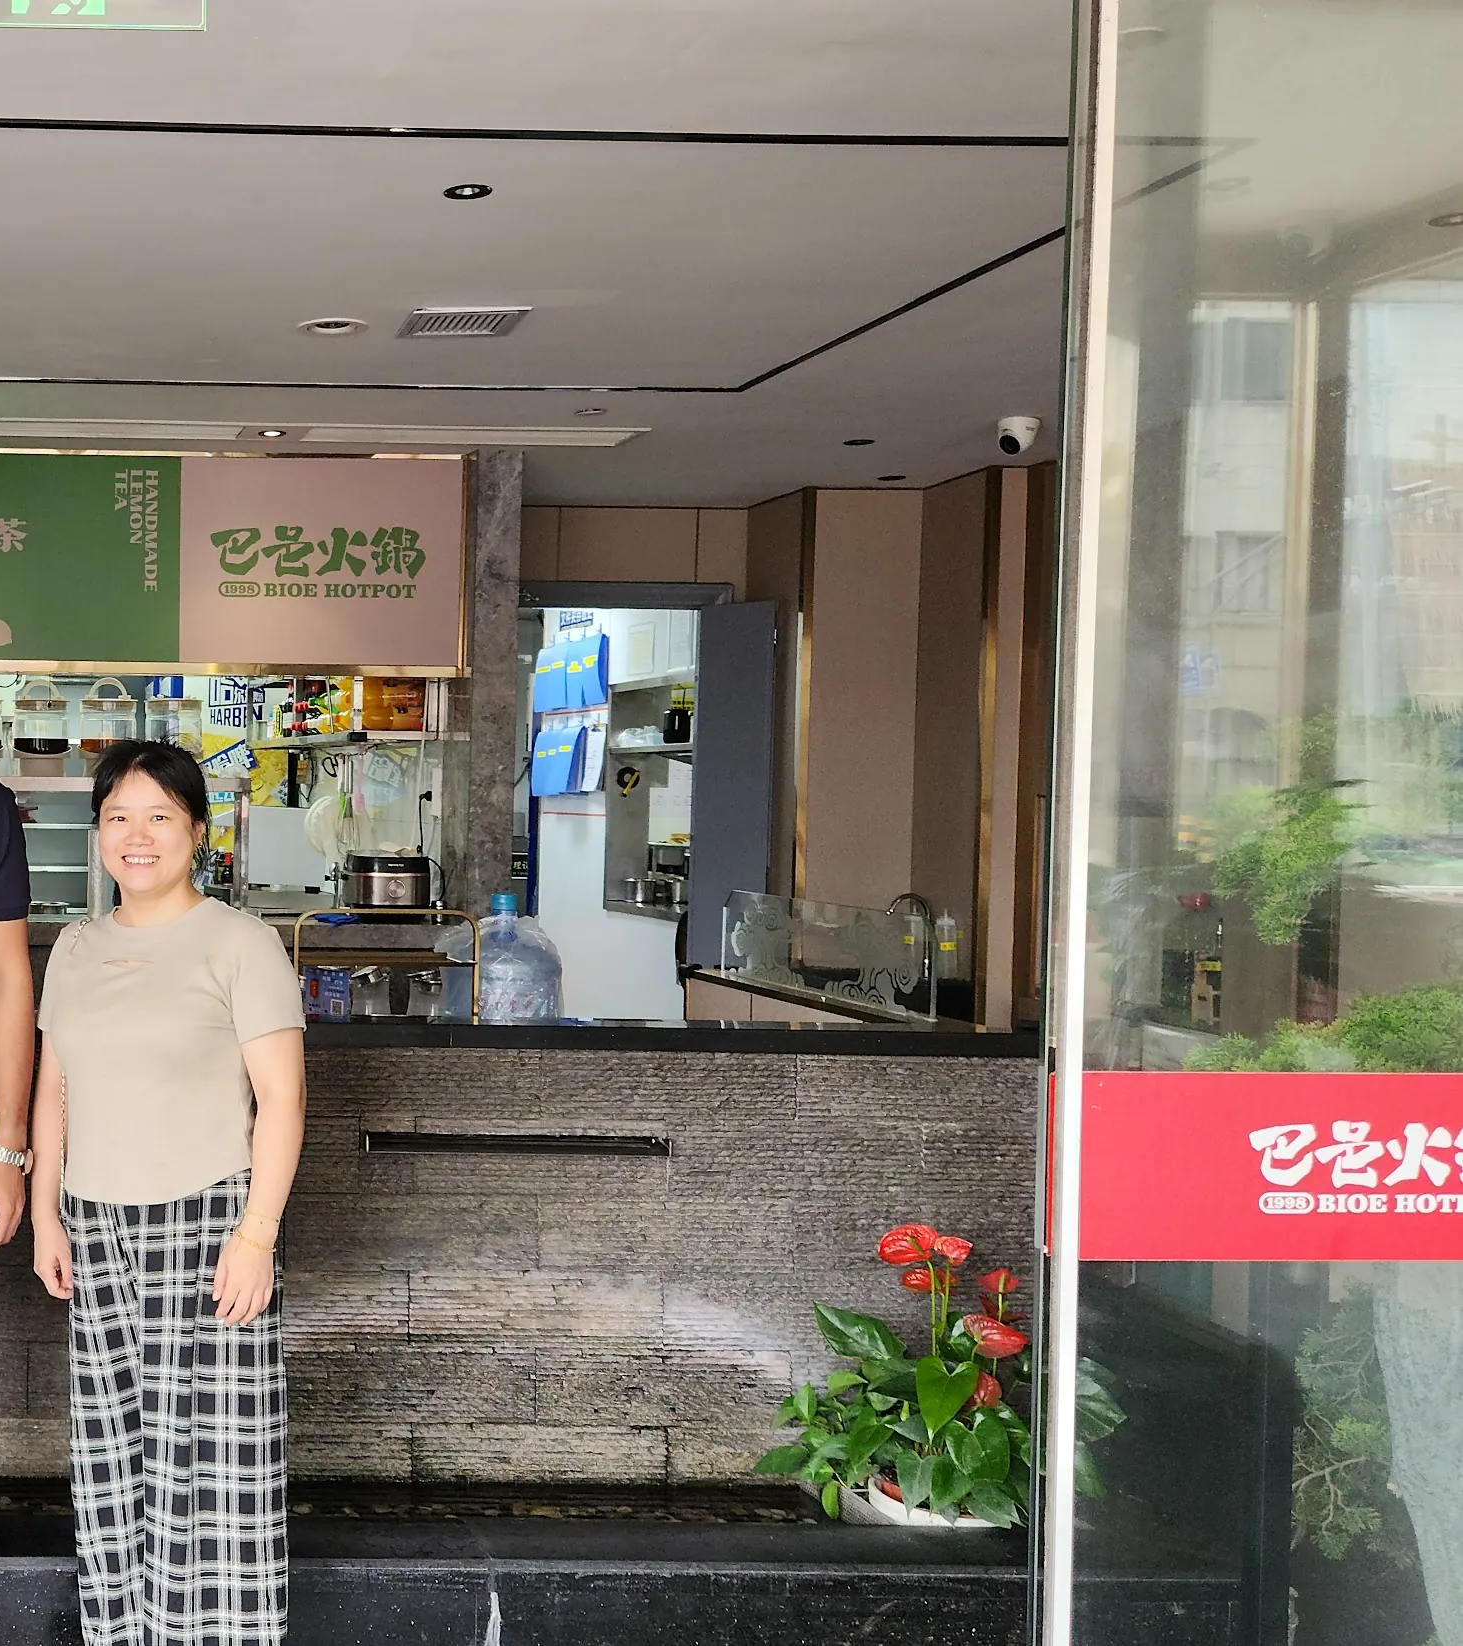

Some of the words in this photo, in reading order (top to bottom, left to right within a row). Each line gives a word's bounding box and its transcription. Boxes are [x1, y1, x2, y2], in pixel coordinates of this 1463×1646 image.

[115, 469, 128, 511] TEA
[130, 470, 143, 544] LEMON
[145, 470, 158, 592] HANDMADE
[224, 585, 255, 594] 1998
[264, 583, 317, 597] BIOE
[324, 584, 416, 598] HOTPOT
[1249, 1120, 1463, 1188] 巴邑火
[1266, 1197, 1308, 1209] 1998
[1317, 1194, 1388, 1213] BIOE
